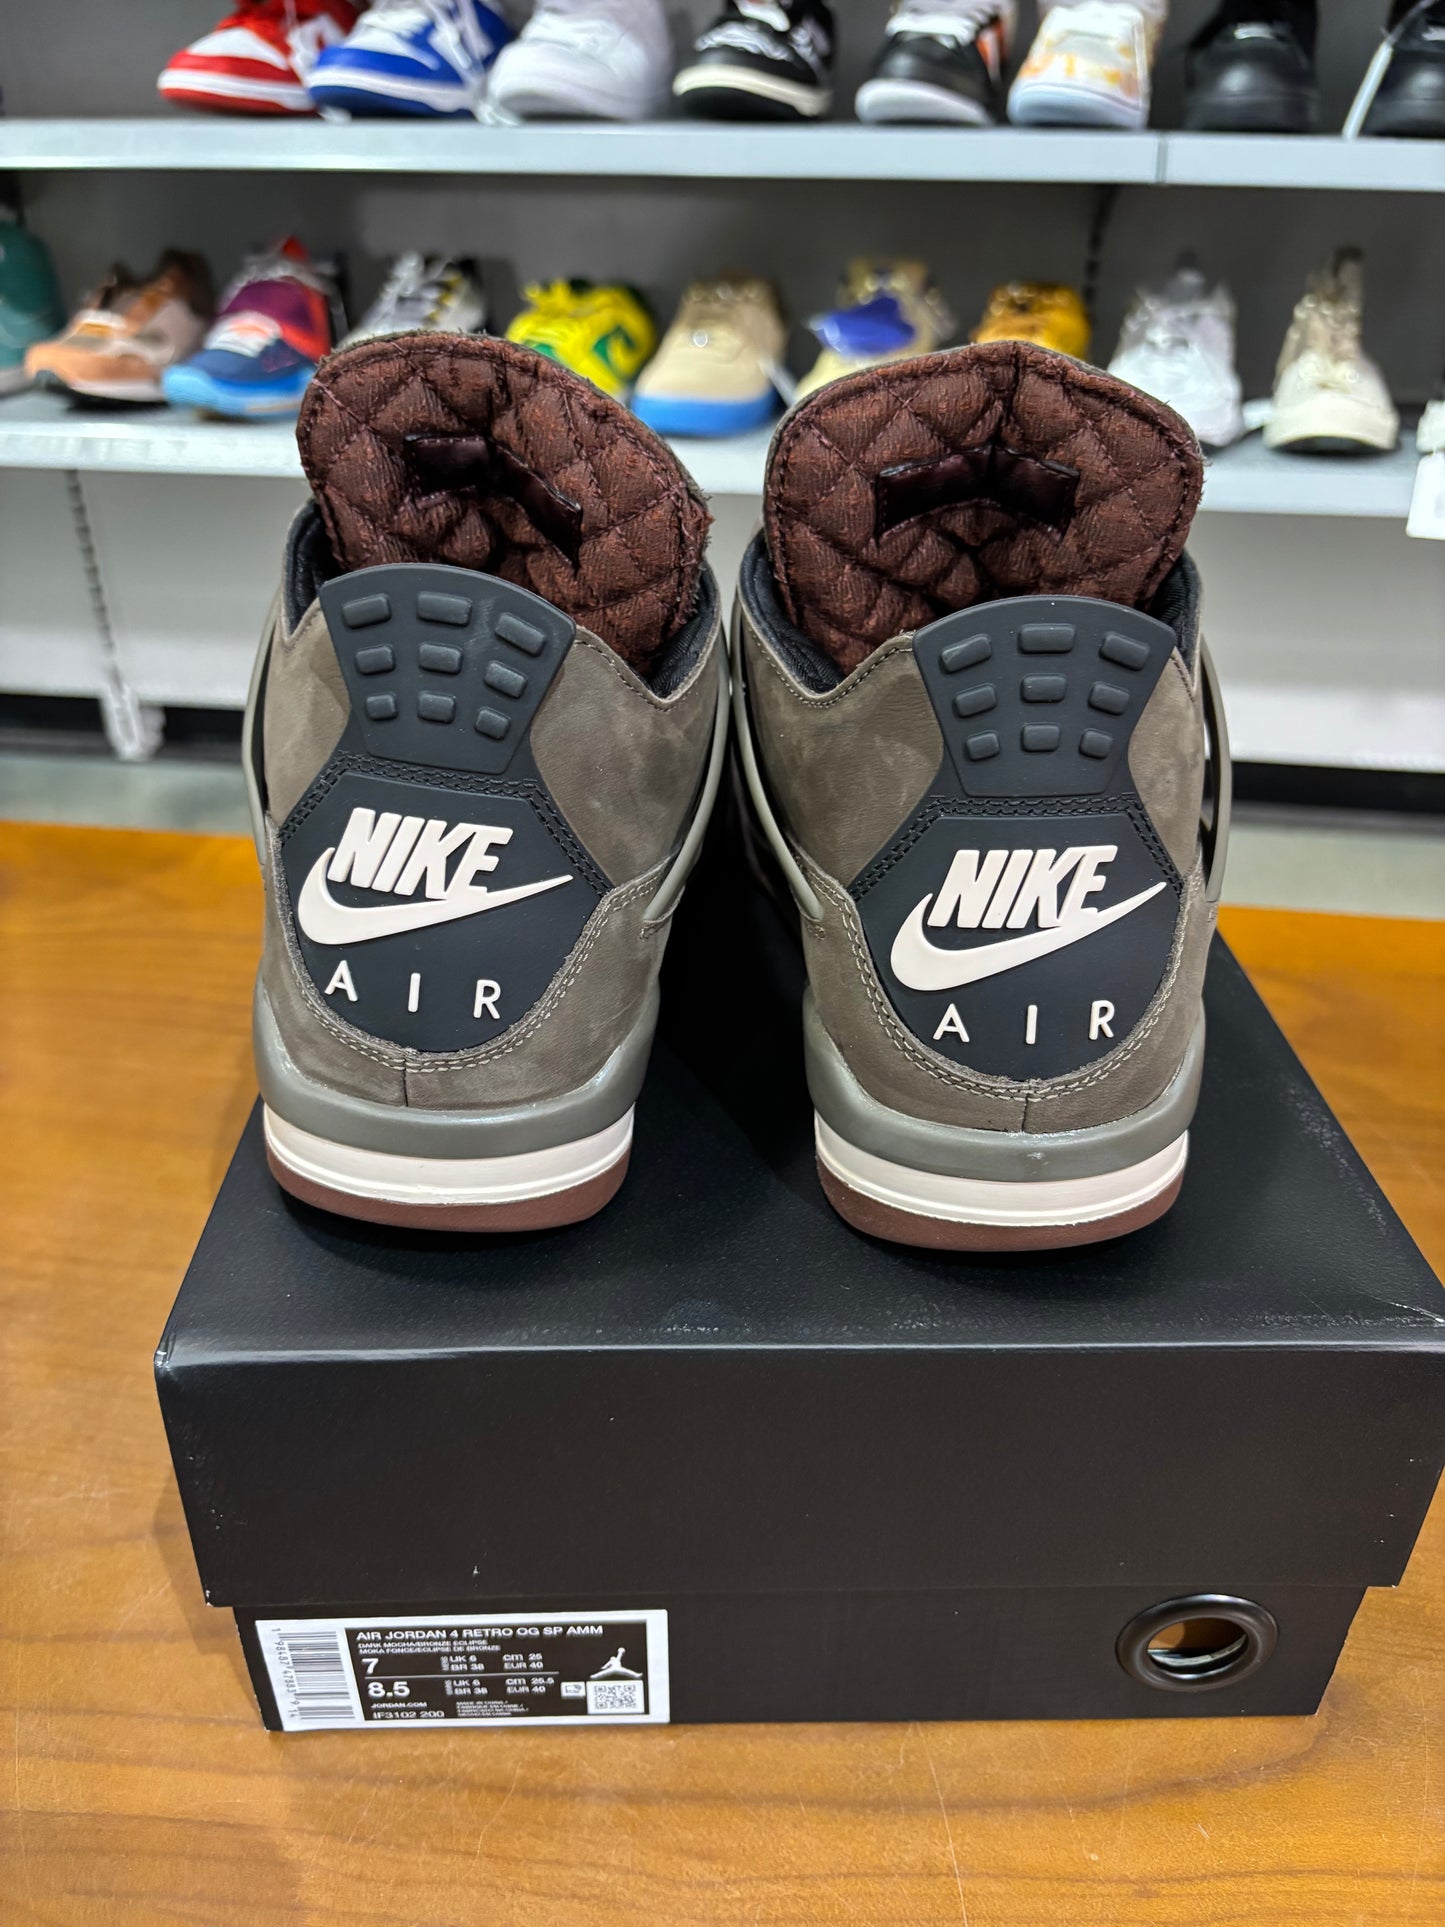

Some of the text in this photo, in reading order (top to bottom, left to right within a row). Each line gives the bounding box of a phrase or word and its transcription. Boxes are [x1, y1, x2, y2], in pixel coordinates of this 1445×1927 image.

[327, 806, 514, 901] NIKE
[927, 845, 1119, 930] NIKE
[324, 959, 502, 1021] AIR
[932, 1000, 1116, 1046] AIR
[356, 1625, 603, 1640] AIR JORDAN 4 RETRO OG SP AMM
[359, 1647, 385, 1655] MOKA
[466, 1644, 501, 1652] BRONZE
[450, 1655, 467, 1663] UK
[528, 1652, 543, 1662] 25
[361, 1658, 379, 1675] 7
[450, 1663, 468, 1671] BR
[503, 1661, 544, 1671] EUR 40
[453, 1679, 470, 1687] UK
[367, 1681, 411, 1699] 8.5
[454, 1687, 472, 1695] BR
[506, 1685, 546, 1694] EUR 40
[371, 1701, 428, 1709] JORDAN.COM
[373, 1710, 445, 1719] IF3102 200
